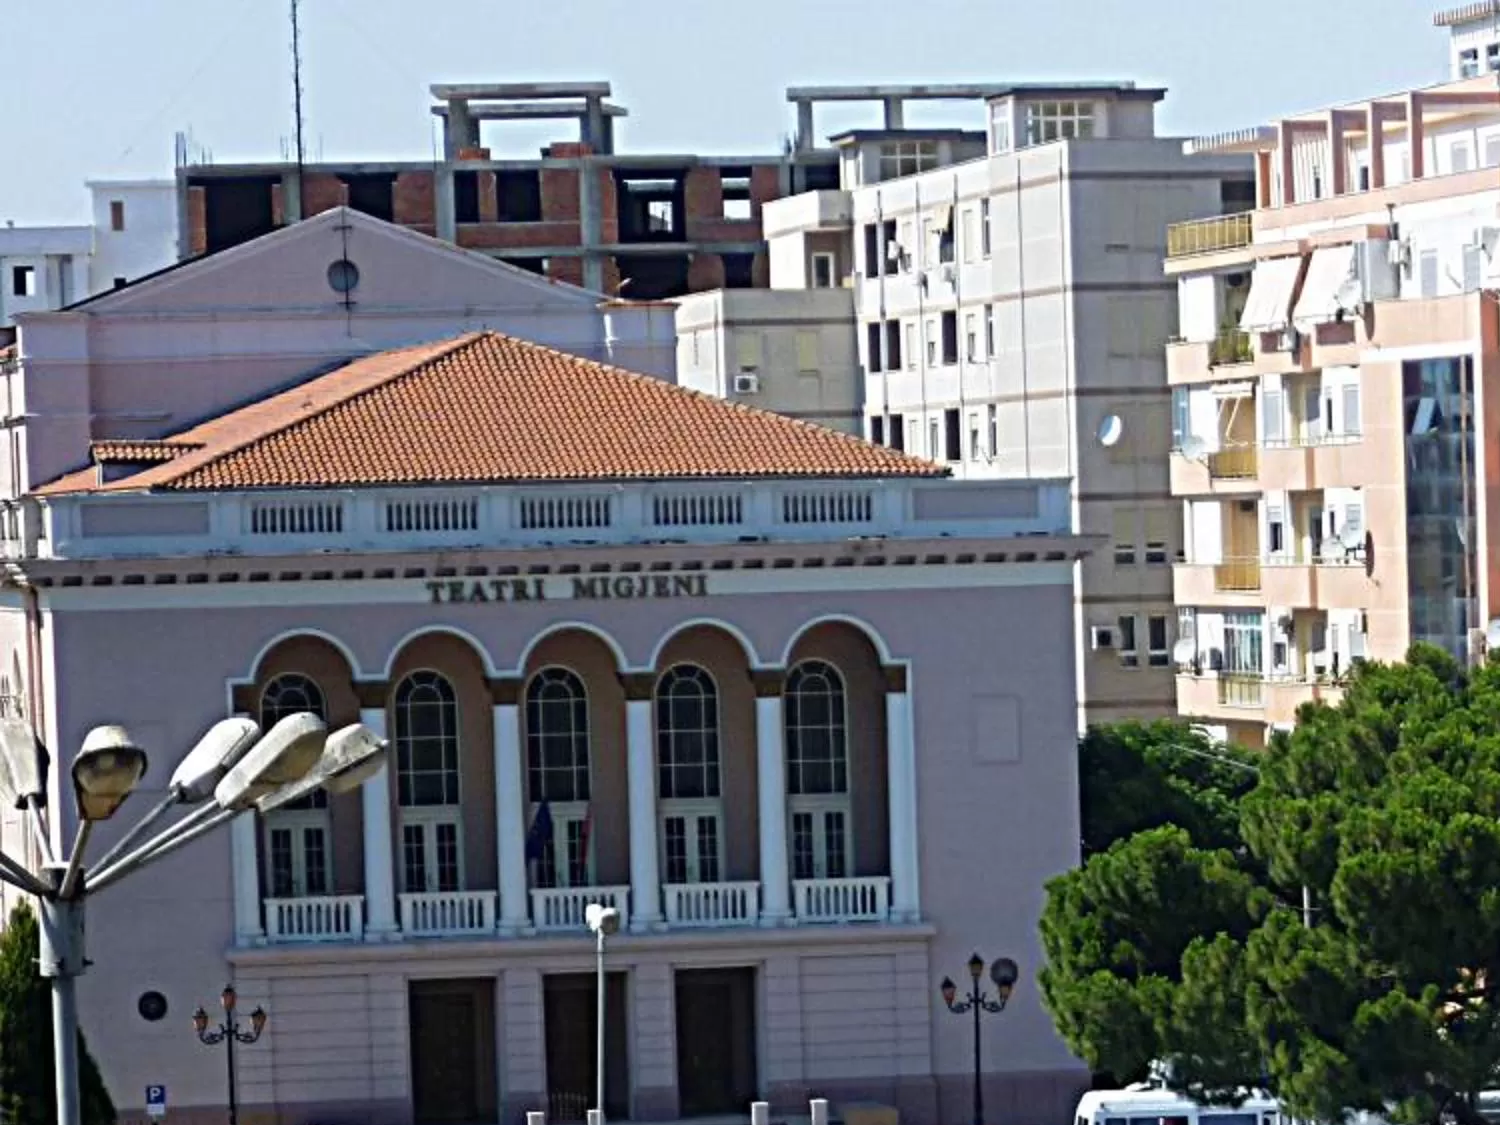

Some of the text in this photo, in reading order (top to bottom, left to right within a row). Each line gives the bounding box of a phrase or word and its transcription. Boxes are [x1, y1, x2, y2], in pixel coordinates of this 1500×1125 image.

[426, 574, 708, 603] TEATRI MIGJENI
[150, 1087, 161, 1101] P
